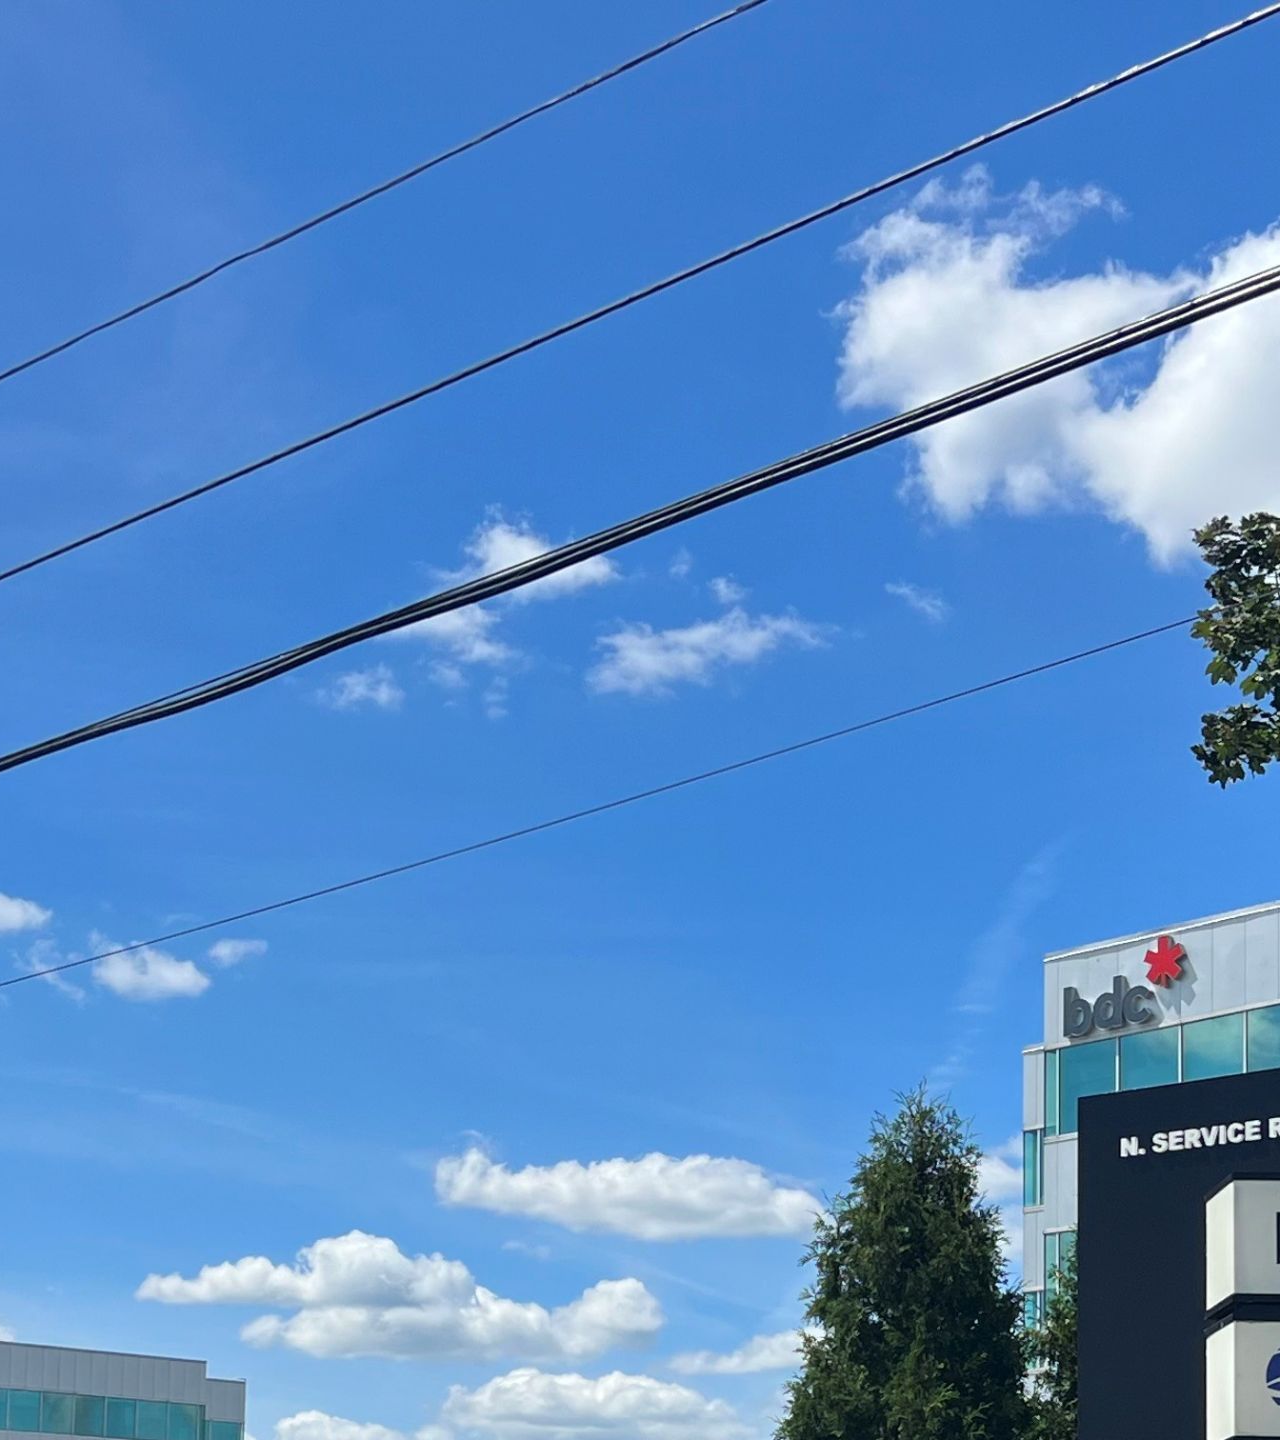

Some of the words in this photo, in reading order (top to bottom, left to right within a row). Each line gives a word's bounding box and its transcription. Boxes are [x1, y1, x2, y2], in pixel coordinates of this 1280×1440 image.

[1063, 974, 1157, 1038] bdc
[1120, 1136, 1146, 1157] N.
[1151, 1119, 1262, 1153] SERVICE
